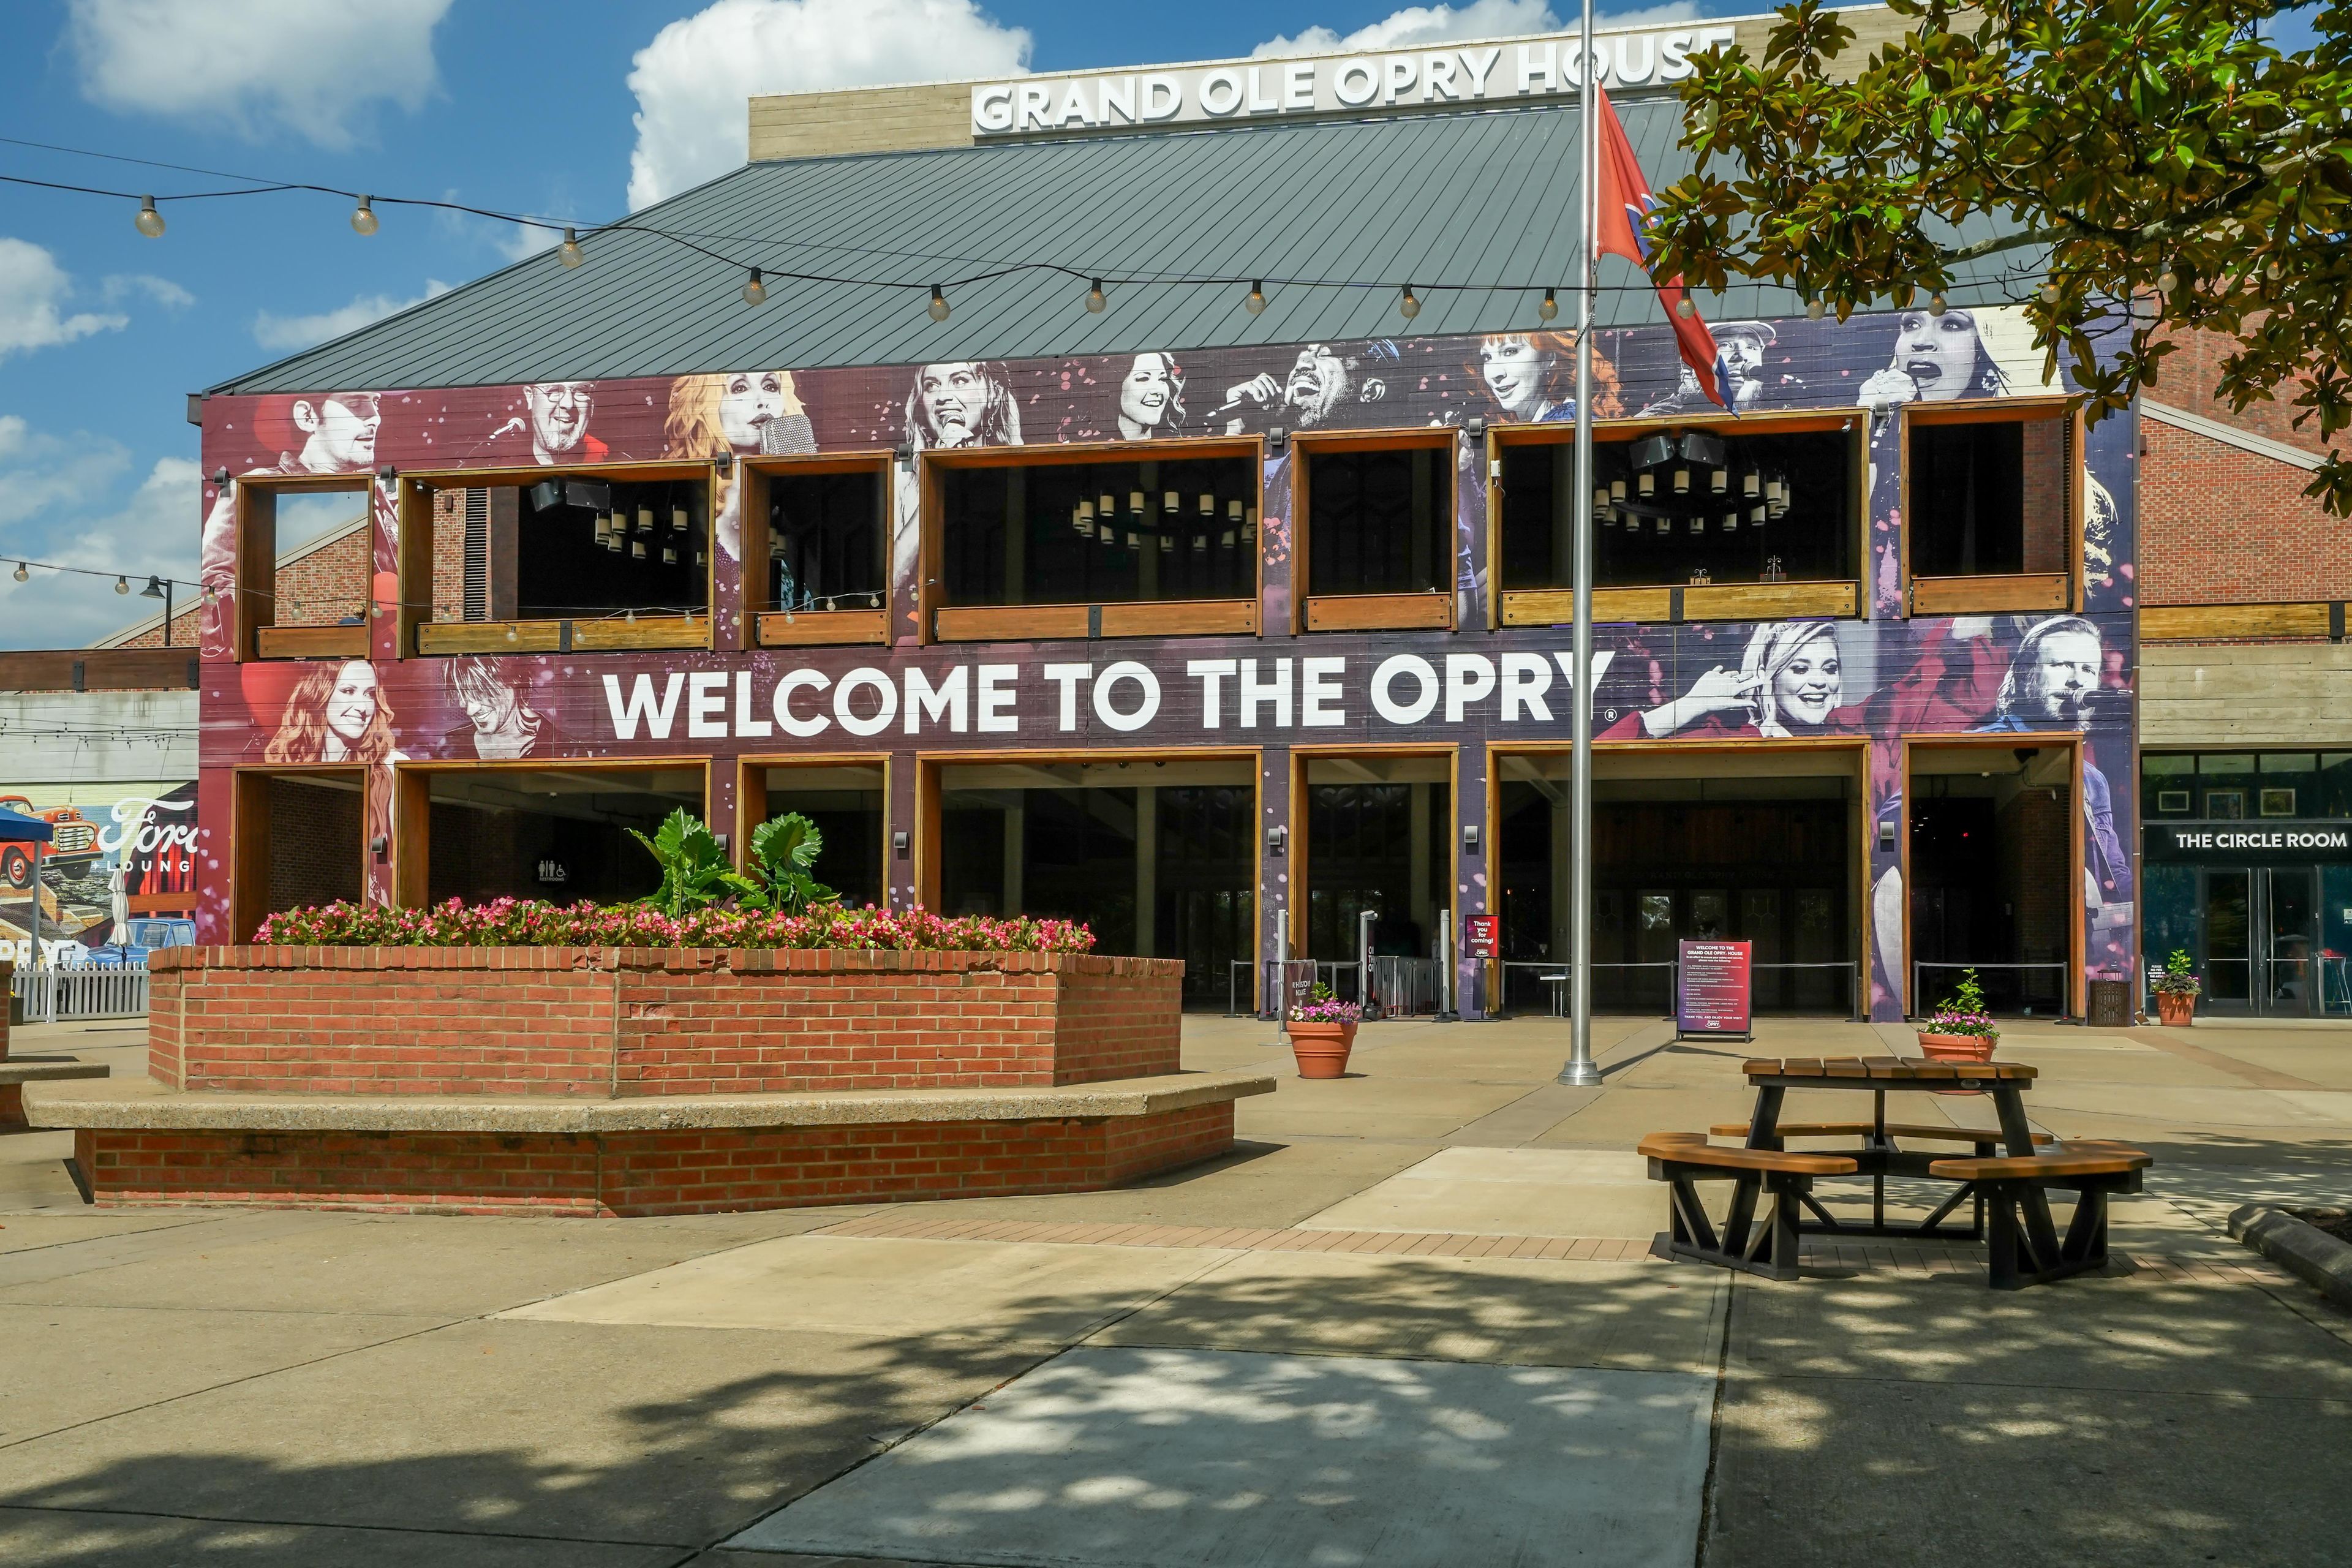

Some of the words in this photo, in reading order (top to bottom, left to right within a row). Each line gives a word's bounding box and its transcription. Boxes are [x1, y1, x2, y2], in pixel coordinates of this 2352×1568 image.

[973, 74, 1183, 131] GRAND
[1199, 62, 1315, 116] OLE
[1334, 48, 1501, 105] OPRY
[602, 664, 1019, 740] WELCOME
[1044, 661, 1161, 731] TO
[1186, 657, 1346, 729] THE
[2176, 834, 2212, 848] THE
[2215, 833, 2282, 848] CIRCLE
[2286, 832, 2347, 848] ROOM
